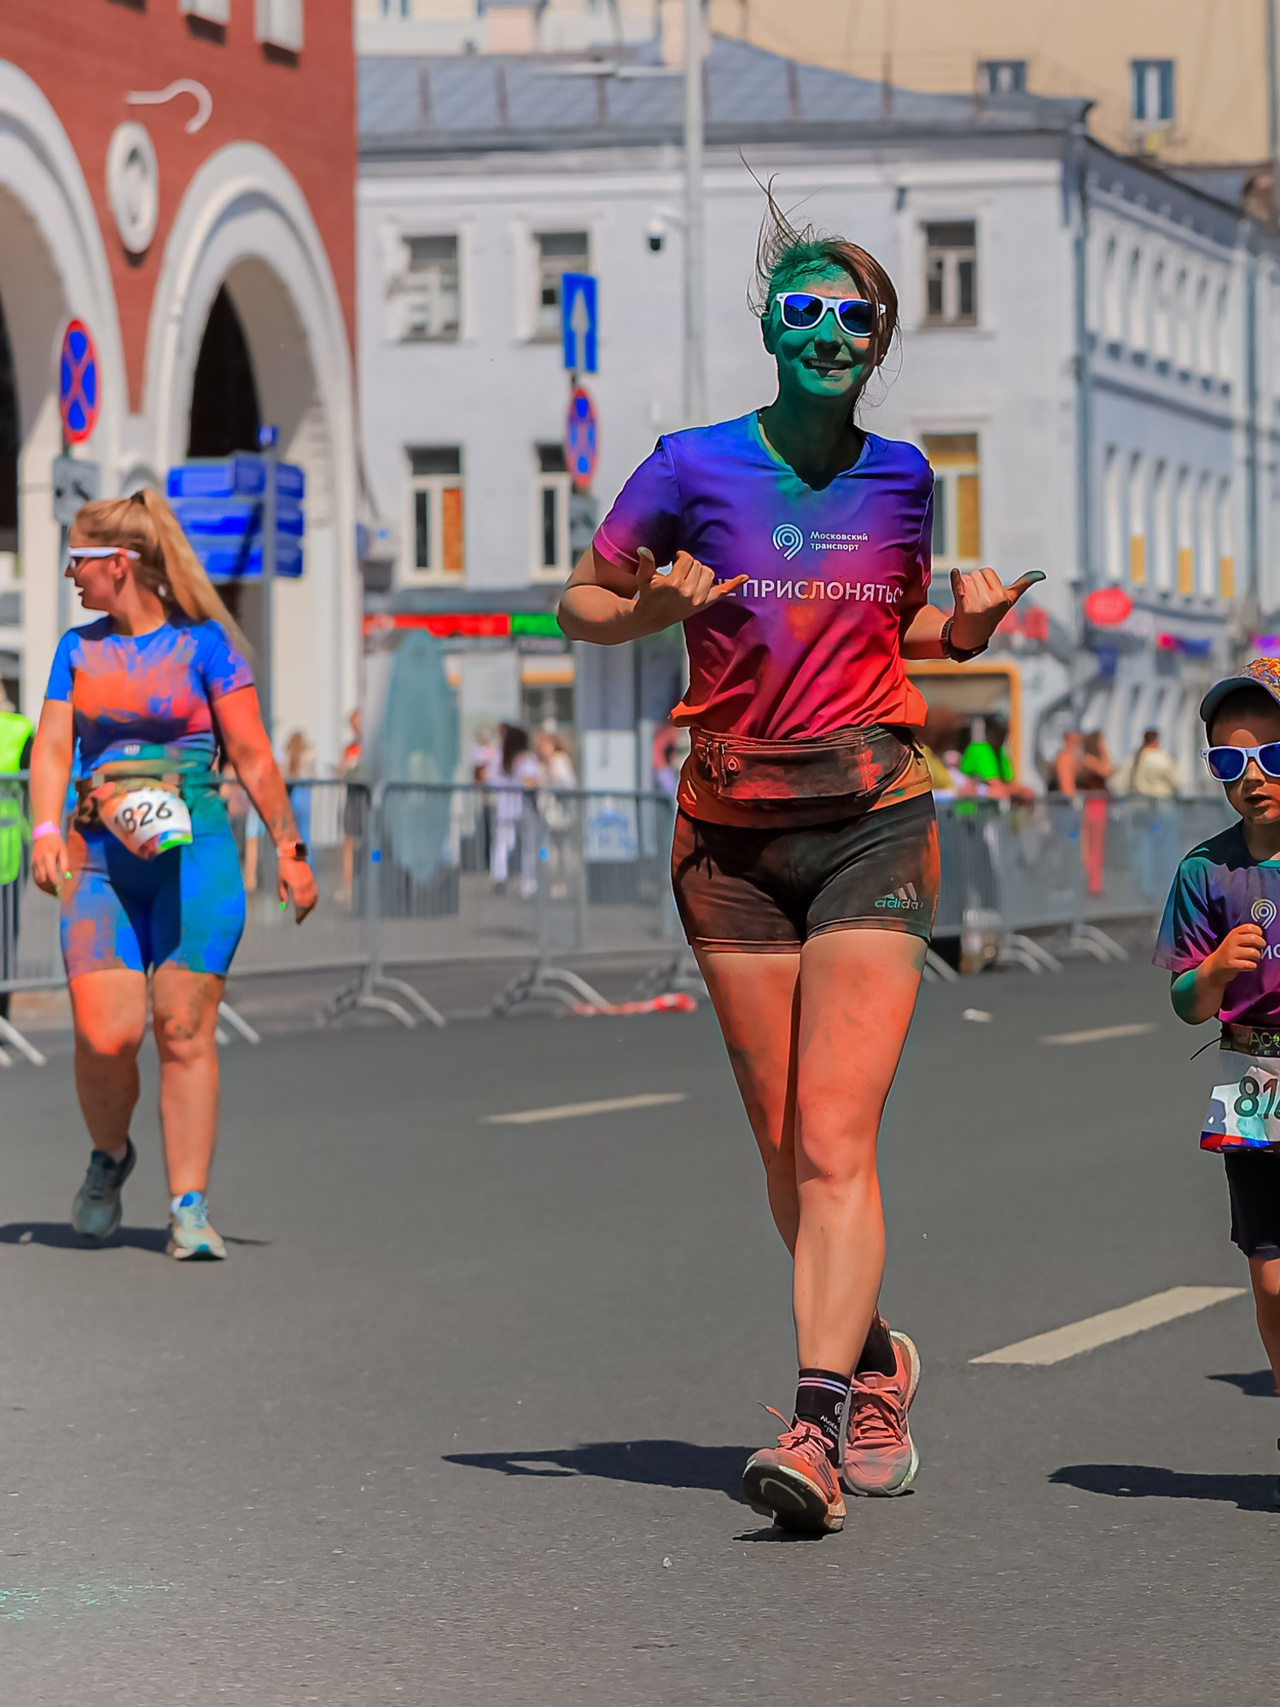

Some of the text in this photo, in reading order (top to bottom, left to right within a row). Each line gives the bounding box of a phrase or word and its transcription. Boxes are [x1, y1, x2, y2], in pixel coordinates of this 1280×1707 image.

[809, 530, 869, 542] Московский
[810, 541, 860, 552] транспорт
[742, 579, 904, 604] ПРИСЛОНЯТЬС
